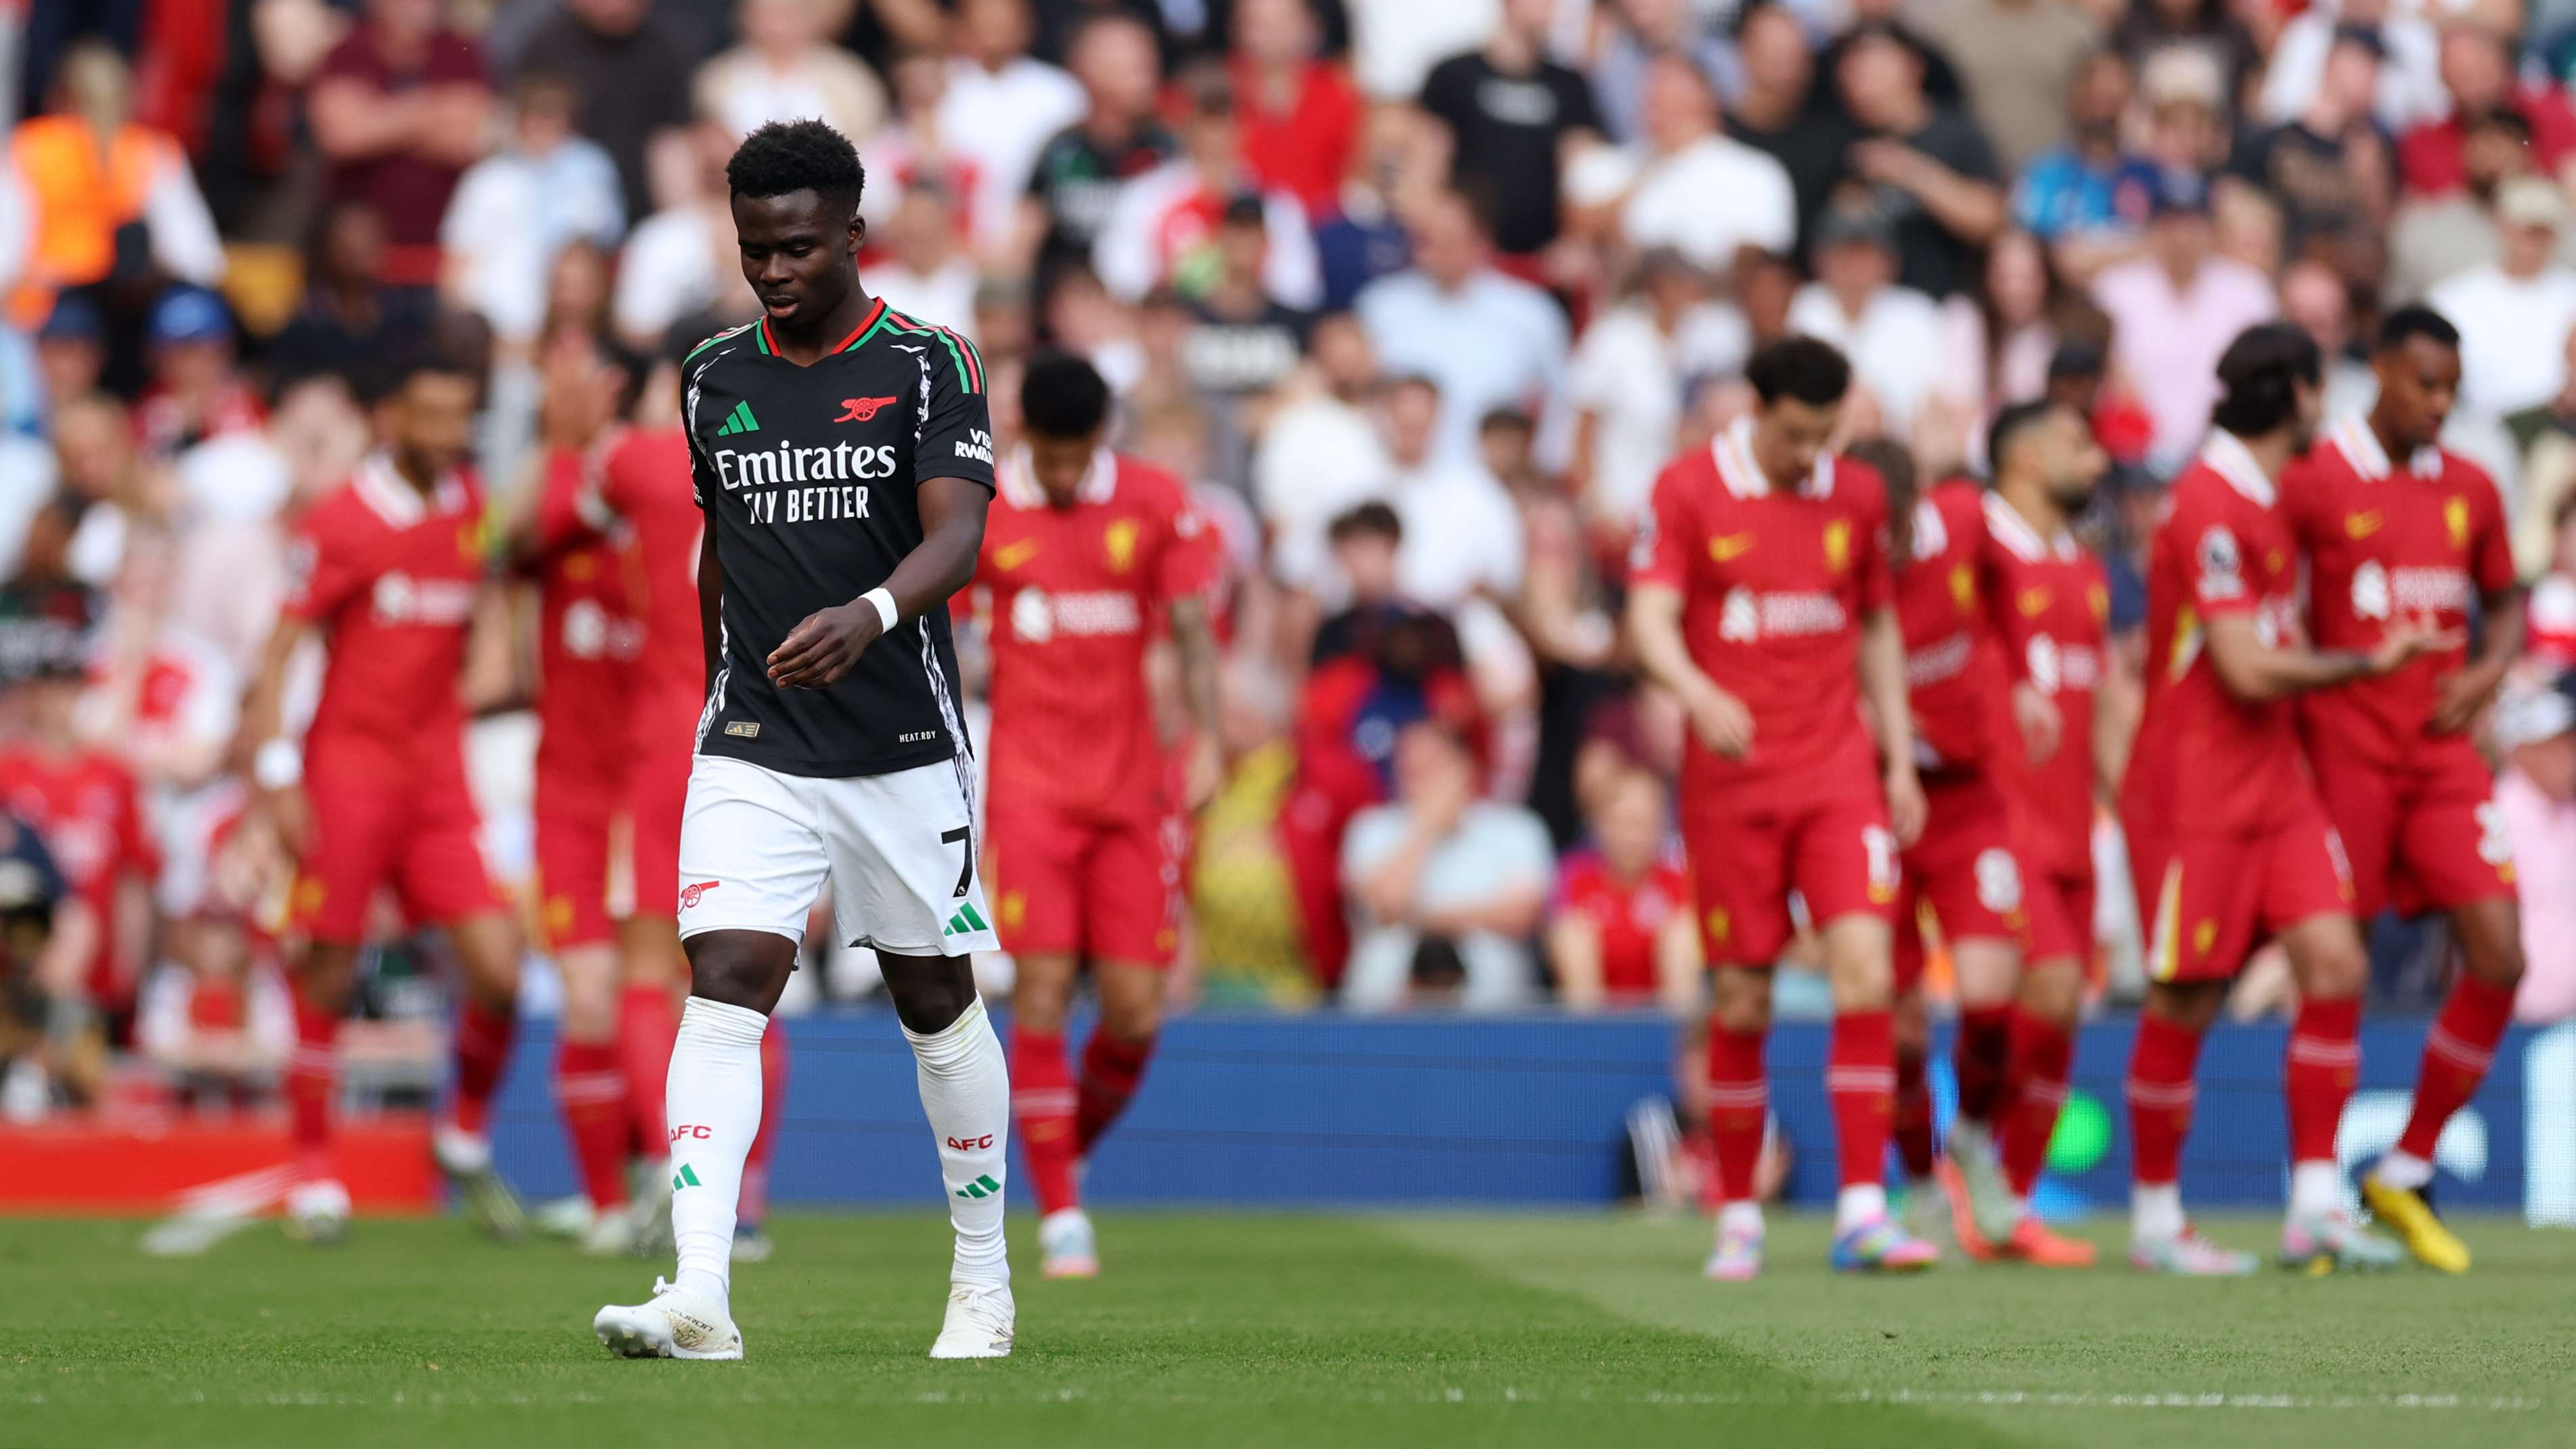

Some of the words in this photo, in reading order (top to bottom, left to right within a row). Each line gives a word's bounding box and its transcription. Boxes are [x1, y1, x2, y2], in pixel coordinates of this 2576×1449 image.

[970, 428, 993, 451] VIS
[715, 440, 897, 491] Emirates
[787, 486, 869, 523] BETTER
[899, 730, 936, 743] HEAT.RDY
[941, 824, 973, 897] 7
[670, 1125, 712, 1145] AFC
[947, 1134, 993, 1151] AFC
